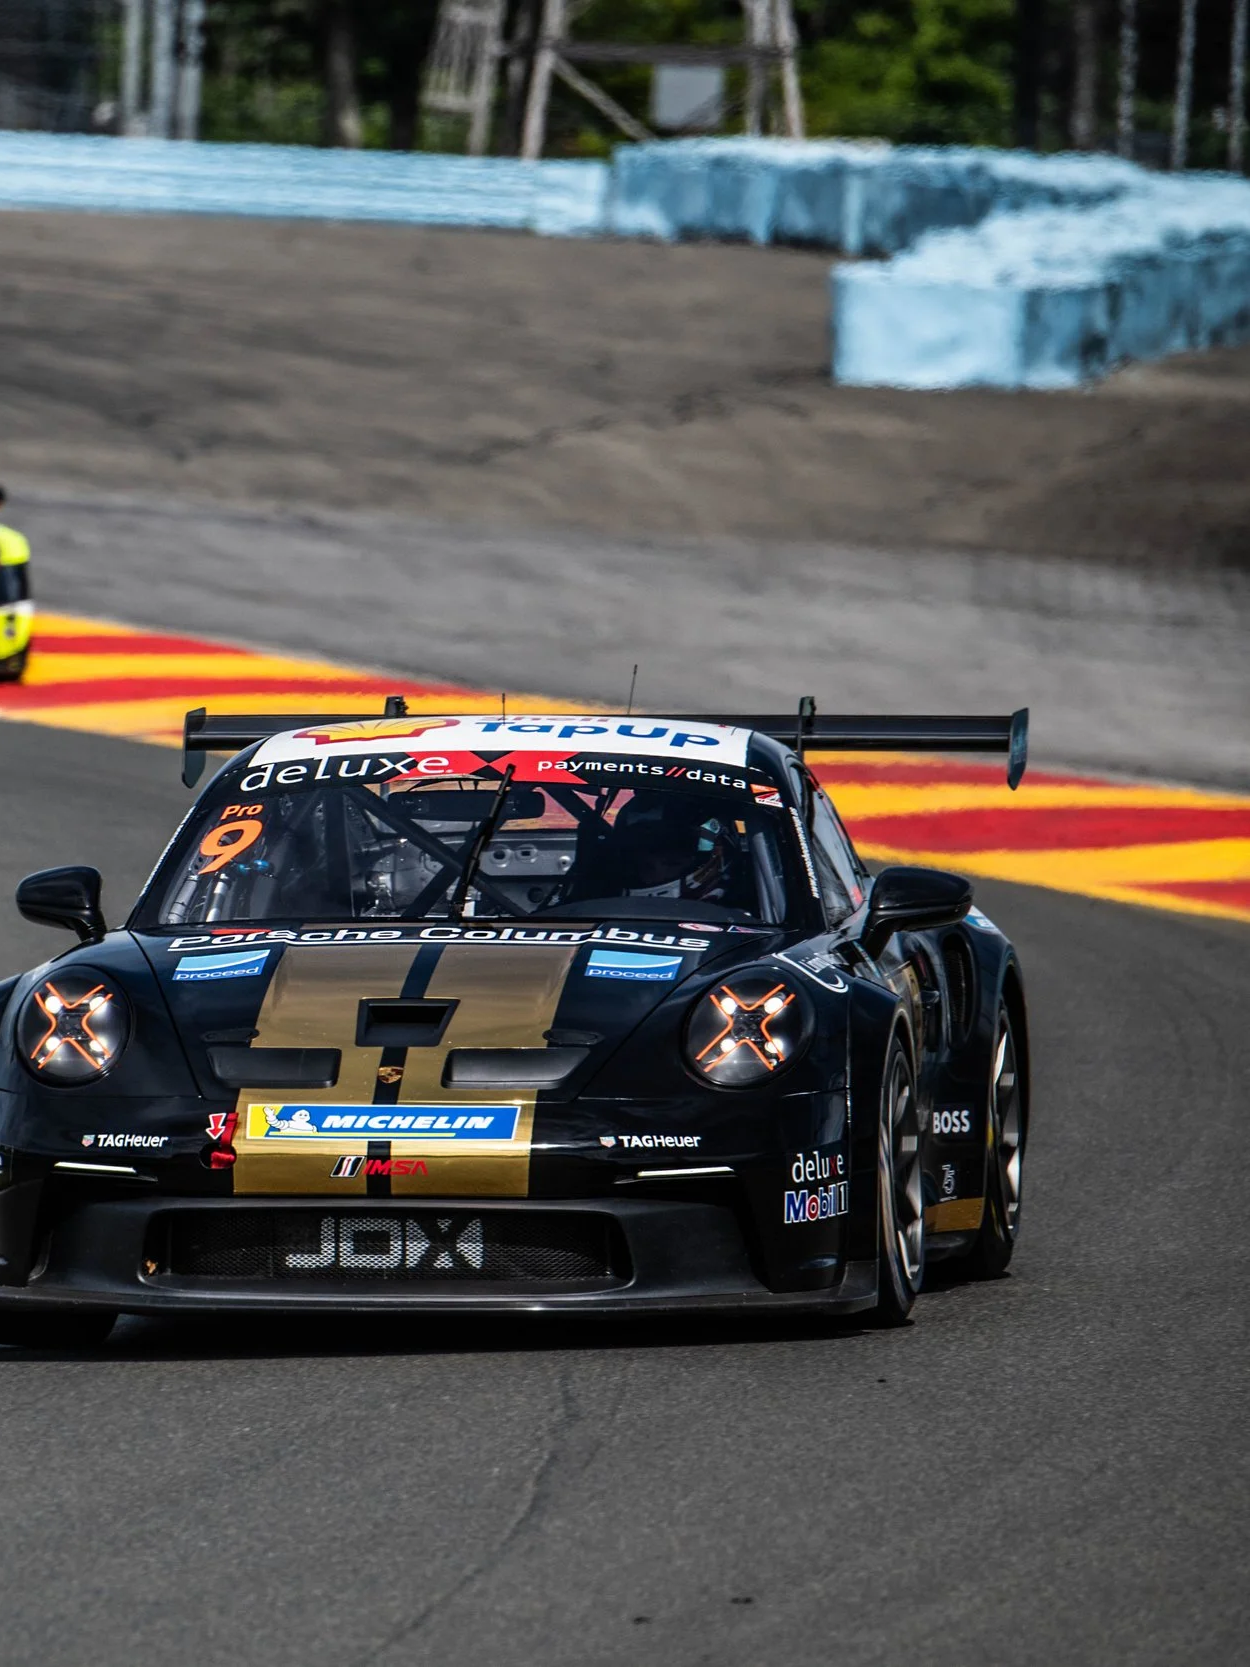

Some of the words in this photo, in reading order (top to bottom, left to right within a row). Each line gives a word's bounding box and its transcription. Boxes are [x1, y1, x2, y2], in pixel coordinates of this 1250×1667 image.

[475, 721, 720, 747] TapUp
[220, 803, 263, 820] Pro
[198, 819, 263, 874] 9
[169, 929, 402, 948] Porsche
[419, 927, 711, 948] Columbus
[176, 966, 259, 980] proceed
[588, 968, 675, 980] proceed
[321, 1114, 495, 1130] MICHELIN
[932, 1109, 970, 1134] BOSS
[361, 1159, 429, 1176] IMSA
[792, 1150, 844, 1183] deluxe
